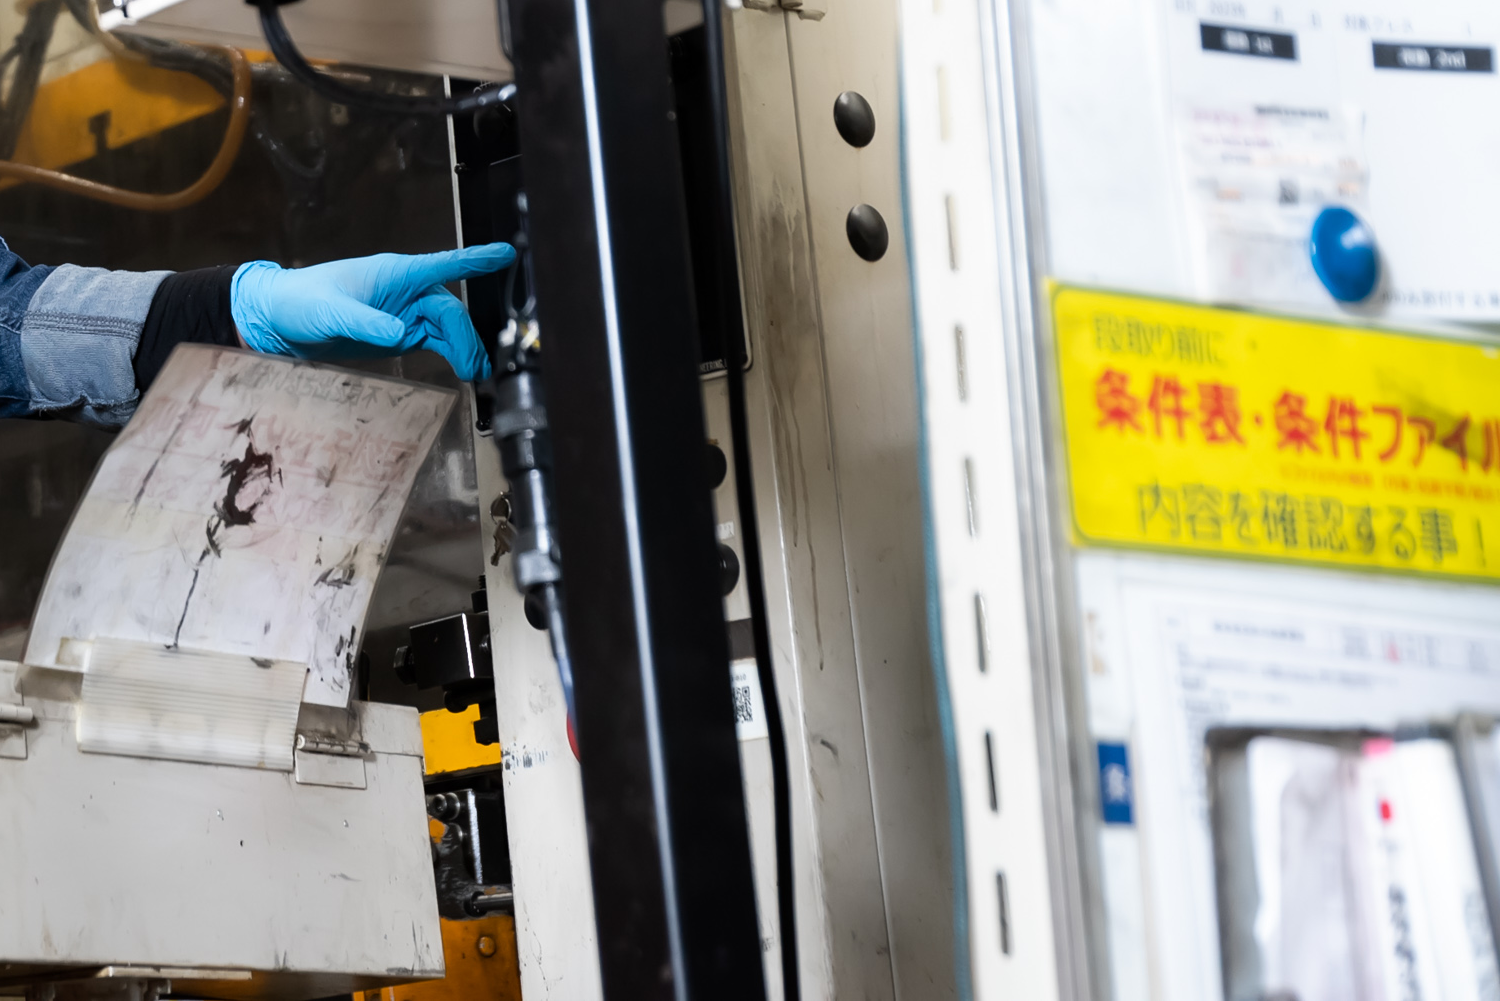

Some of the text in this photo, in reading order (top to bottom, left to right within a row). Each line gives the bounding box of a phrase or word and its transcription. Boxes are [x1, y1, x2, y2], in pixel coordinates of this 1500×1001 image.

[1094, 315, 1226, 366] 段取り前に
